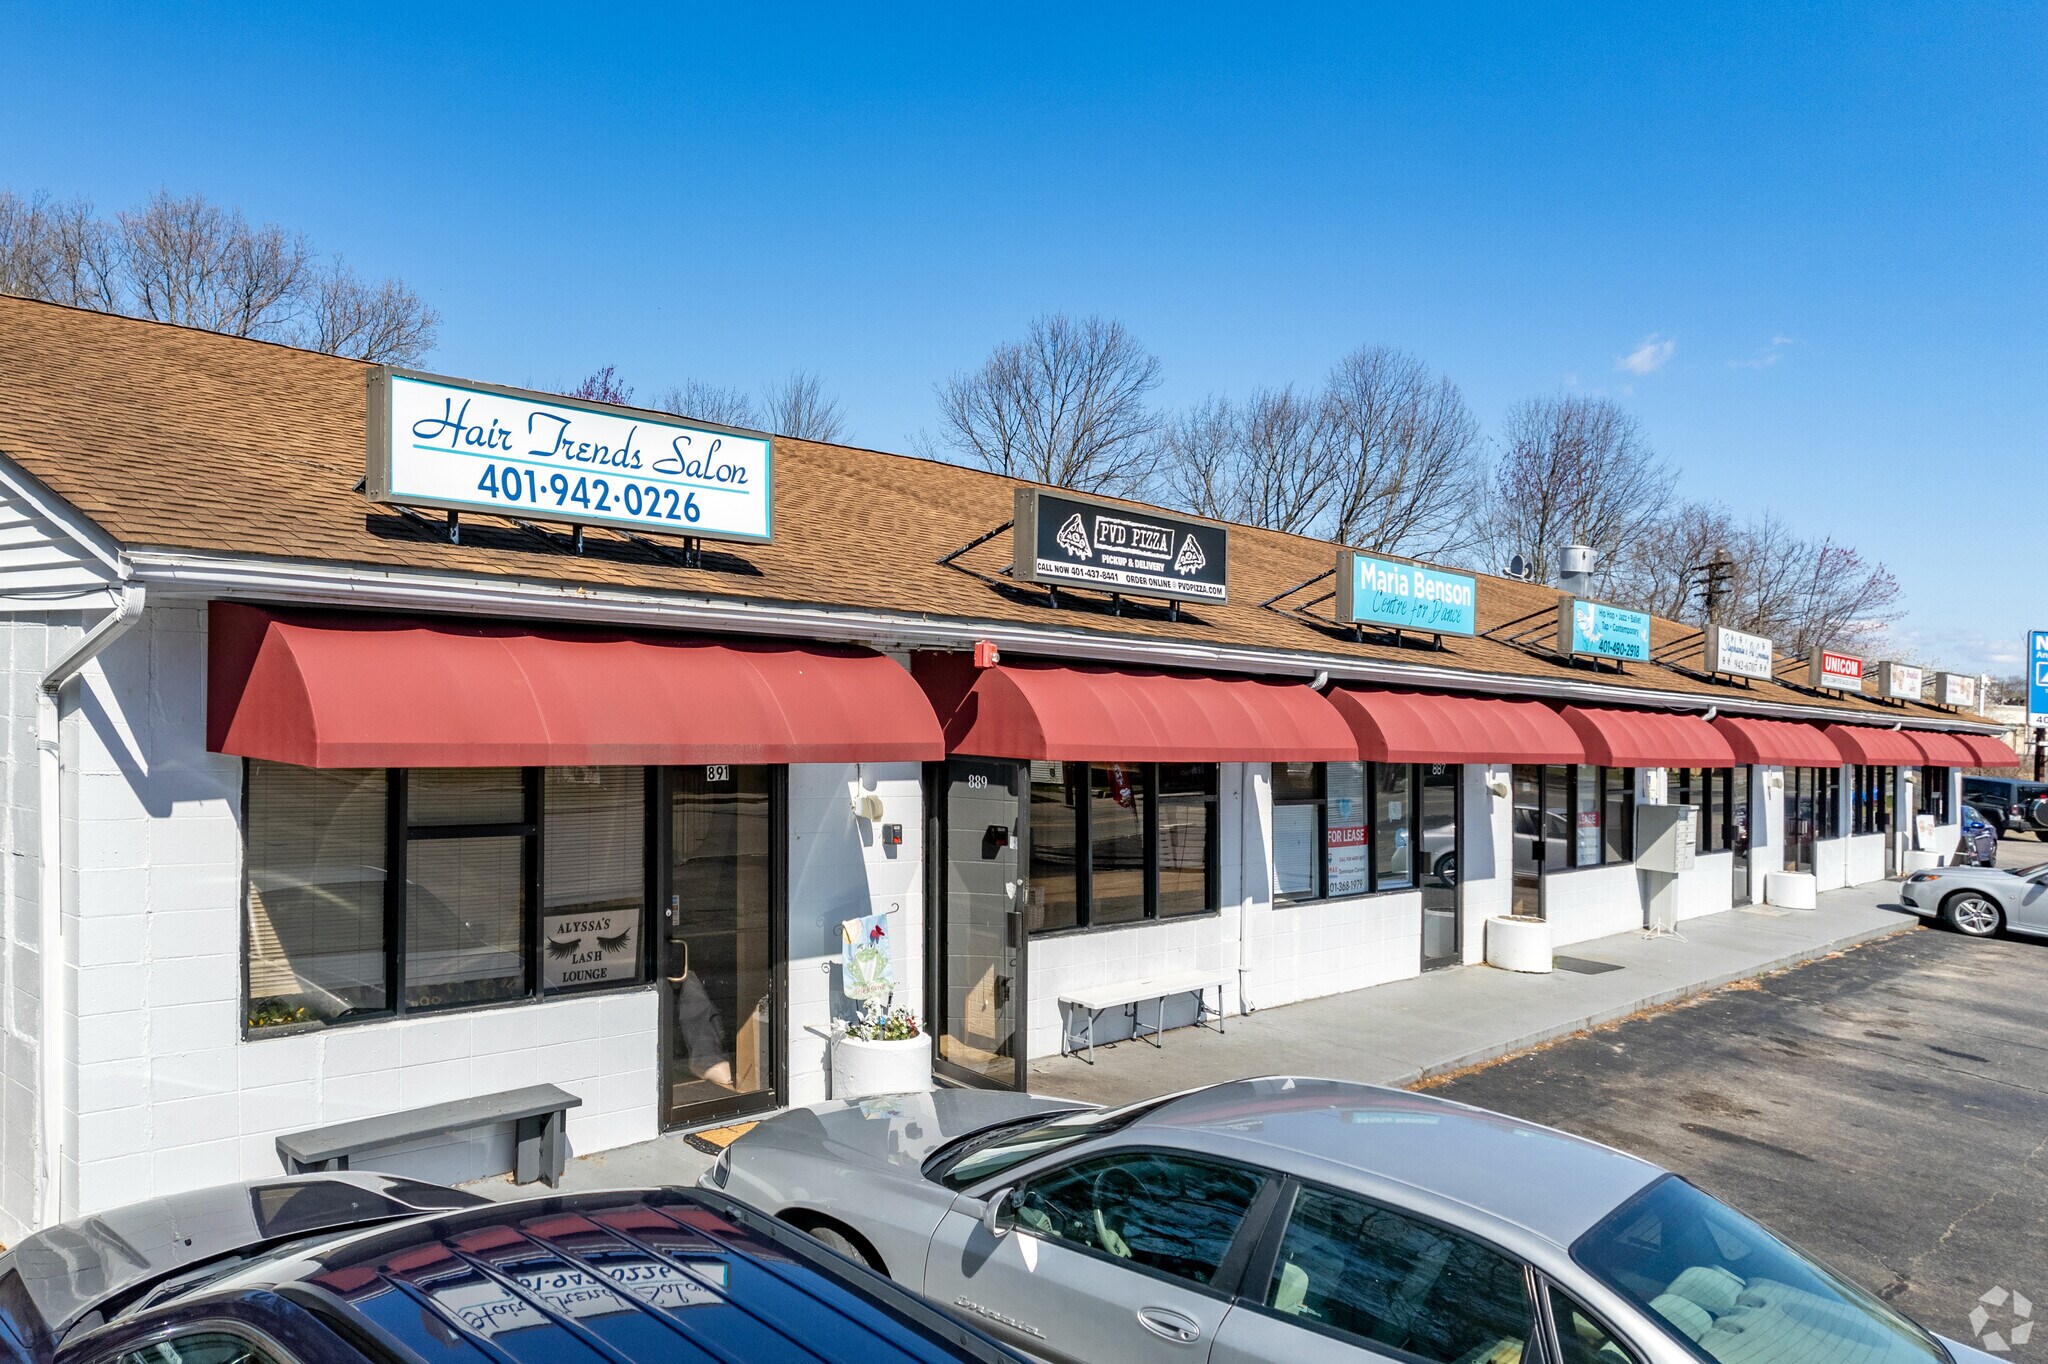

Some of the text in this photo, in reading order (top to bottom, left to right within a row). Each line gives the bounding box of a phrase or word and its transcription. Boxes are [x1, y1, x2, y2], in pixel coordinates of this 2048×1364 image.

[413, 398, 749, 484] Hair Trends Salon
[1099, 522, 1168, 552] PVD PIZZA
[1037, 562, 1053, 572] CALL
[1054, 564, 1070, 574] NOW
[1101, 554, 1165, 572] PICKUP & DELIVERY
[1125, 574, 1148, 585] ORDER
[1148, 577, 1171, 588] ONLINE
[1178, 582, 1223, 595] PVDPIZZA.COM
[1360, 561, 1471, 606] Maria Benson
[1372, 589, 1462, 625] Centre for Dance
[1825, 656, 1858, 675] UNICOM
[708, 765, 728, 780] 891
[1432, 763, 1446, 775] 887
[968, 774, 988, 789] 889
[1328, 829, 1364, 843] FOR LEASE
[1329, 879, 1363, 892] 01-368-1979
[557, 917, 611, 934] ALYSSA'S
[572, 951, 603, 964] LASH
[562, 968, 608, 983] LOUNGE
